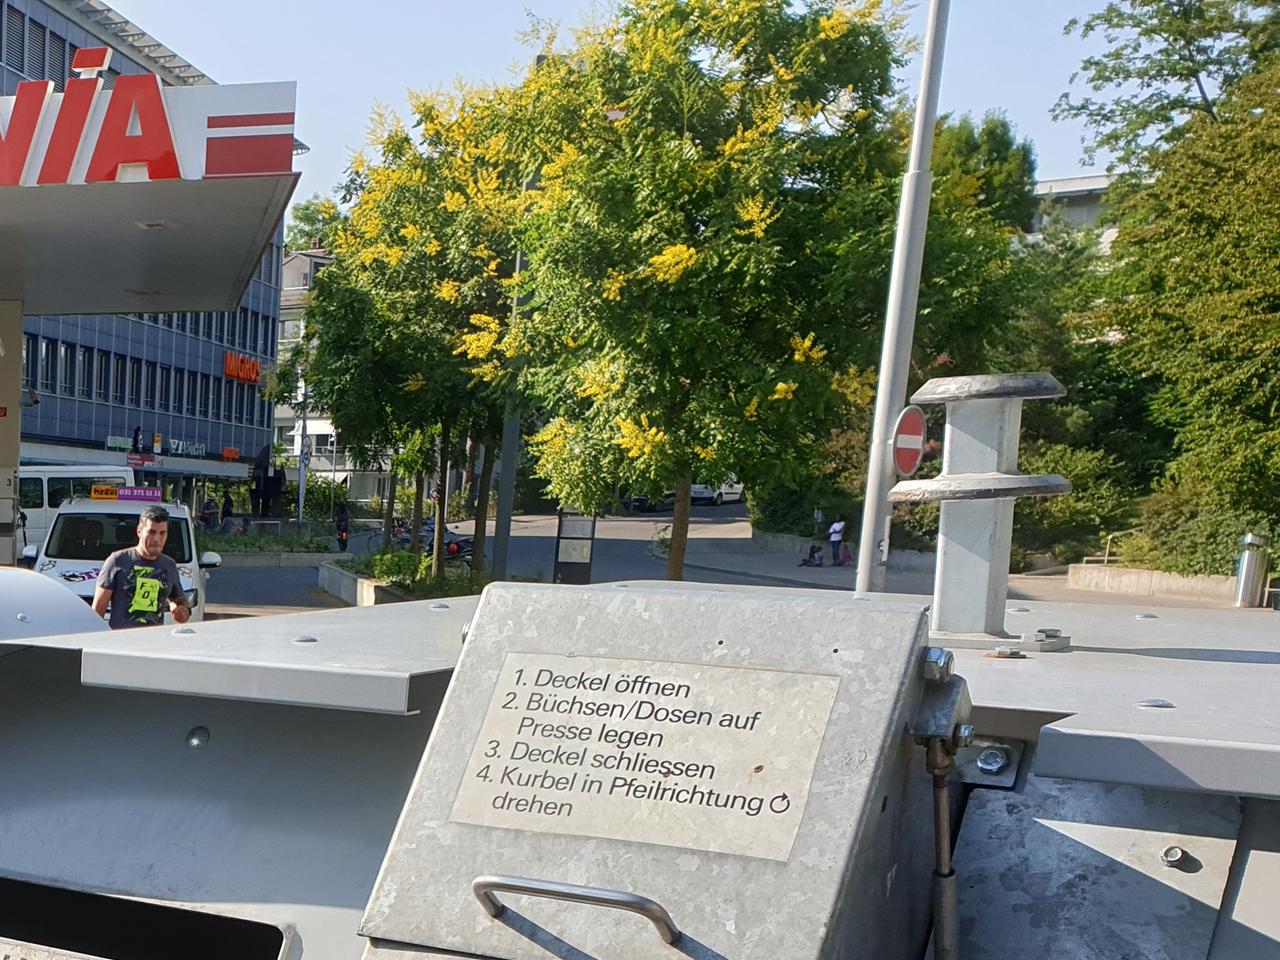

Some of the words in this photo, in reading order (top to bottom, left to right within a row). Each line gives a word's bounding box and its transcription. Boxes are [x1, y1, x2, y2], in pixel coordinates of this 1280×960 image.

[225, 351, 262, 383] MIGROS
[6, 478, 12, 487] 3
[514, 669, 528, 687] 1.
[534, 668, 610, 692] Deckel
[614, 675, 691, 699] öffnen
[502, 692, 519, 711] 2.
[526, 692, 713, 727] Büchsen/Dosen
[718, 711, 762, 731] auf
[517, 717, 592, 742] Presse
[597, 724, 663, 750] legen
[485, 740, 502, 759] 3.
[510, 742, 587, 766] Deckel
[591, 751, 716, 780] schliessen
[476, 764, 494, 783] 4.
[500, 766, 578, 792] Kurbel
[581, 774, 603, 794] in
[609, 776, 764, 817] Pfeilrichtung
[492, 791, 573, 817] drehen
